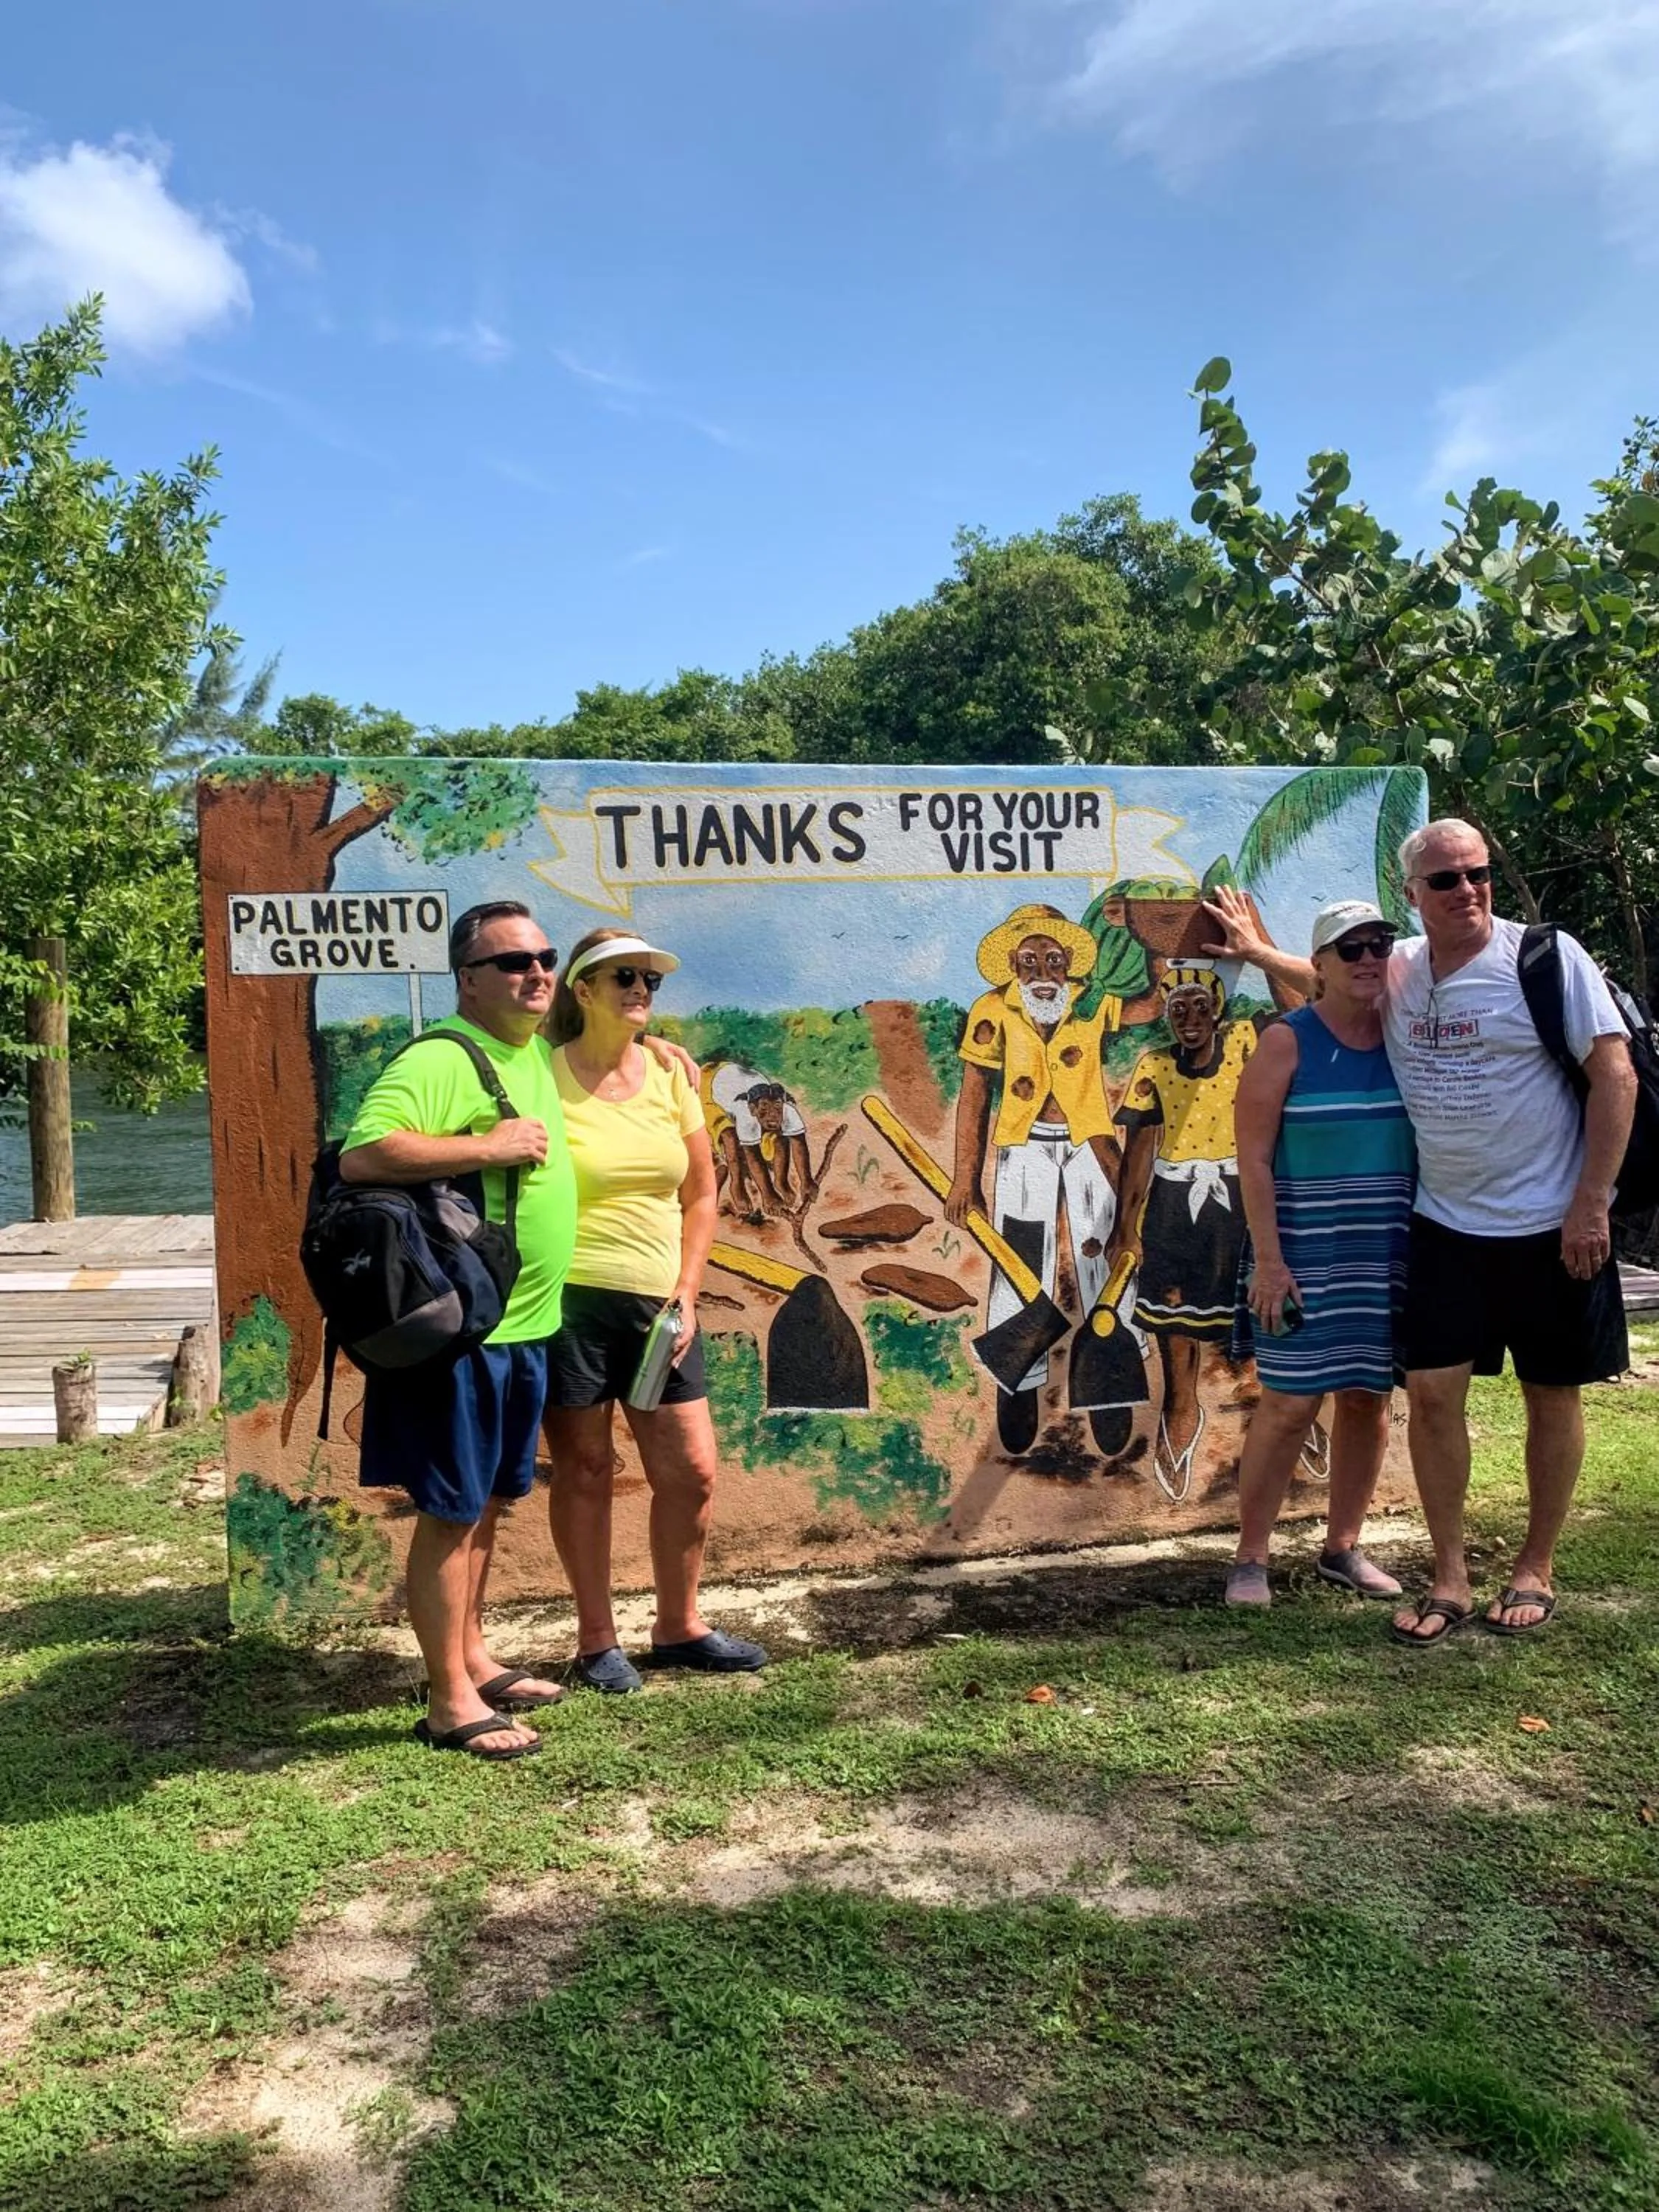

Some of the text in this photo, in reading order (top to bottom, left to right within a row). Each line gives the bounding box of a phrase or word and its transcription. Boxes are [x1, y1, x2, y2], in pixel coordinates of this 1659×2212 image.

[899, 792, 1099, 831] FOR YOUR
[595, 802, 866, 869] THANKS
[941, 831, 1062, 873] VISIT
[232, 896, 442, 935] PALMENTO
